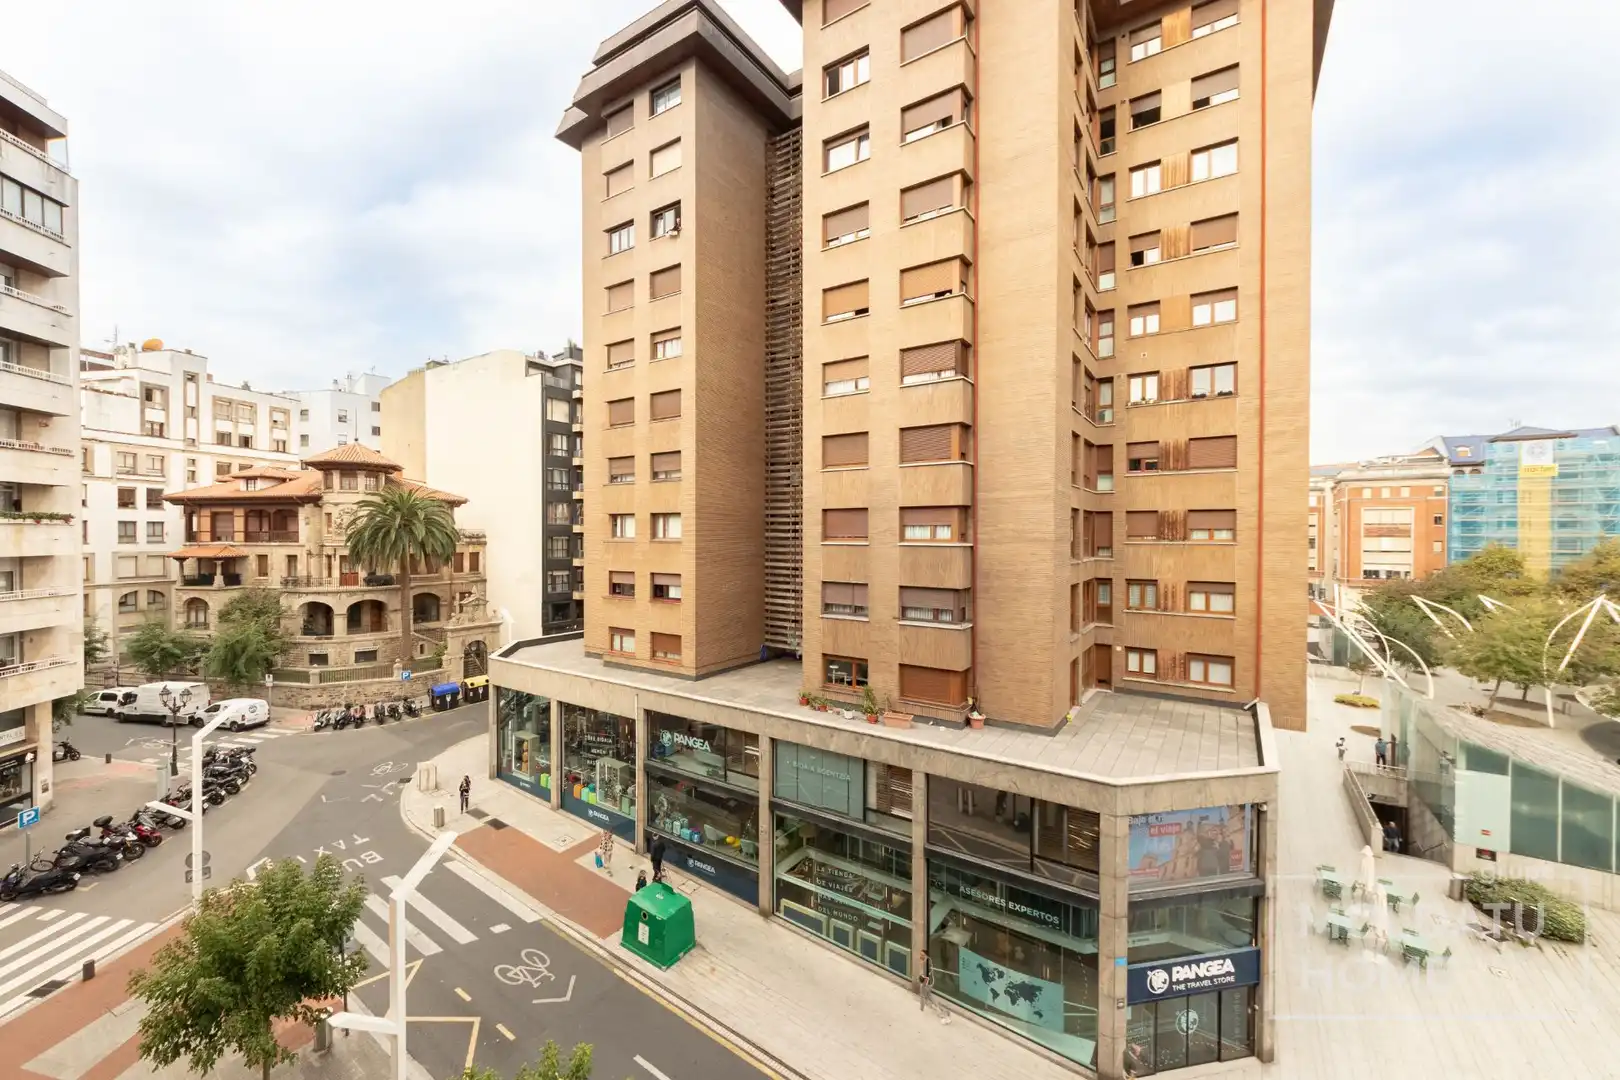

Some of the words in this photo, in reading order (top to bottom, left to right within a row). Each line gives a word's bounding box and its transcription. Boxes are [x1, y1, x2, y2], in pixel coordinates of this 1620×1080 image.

[673, 732, 711, 752] PANGEA
[22, 810, 36, 826] P
[959, 885, 1006, 907] ASESORES
[1008, 901, 1060, 924] EXPERTOS
[1171, 958, 1236, 982] PANGEA
[1172, 984, 1186, 992] THE
[1187, 979, 1212, 989] TRAVEL
[1213, 975, 1236, 985] STORE
